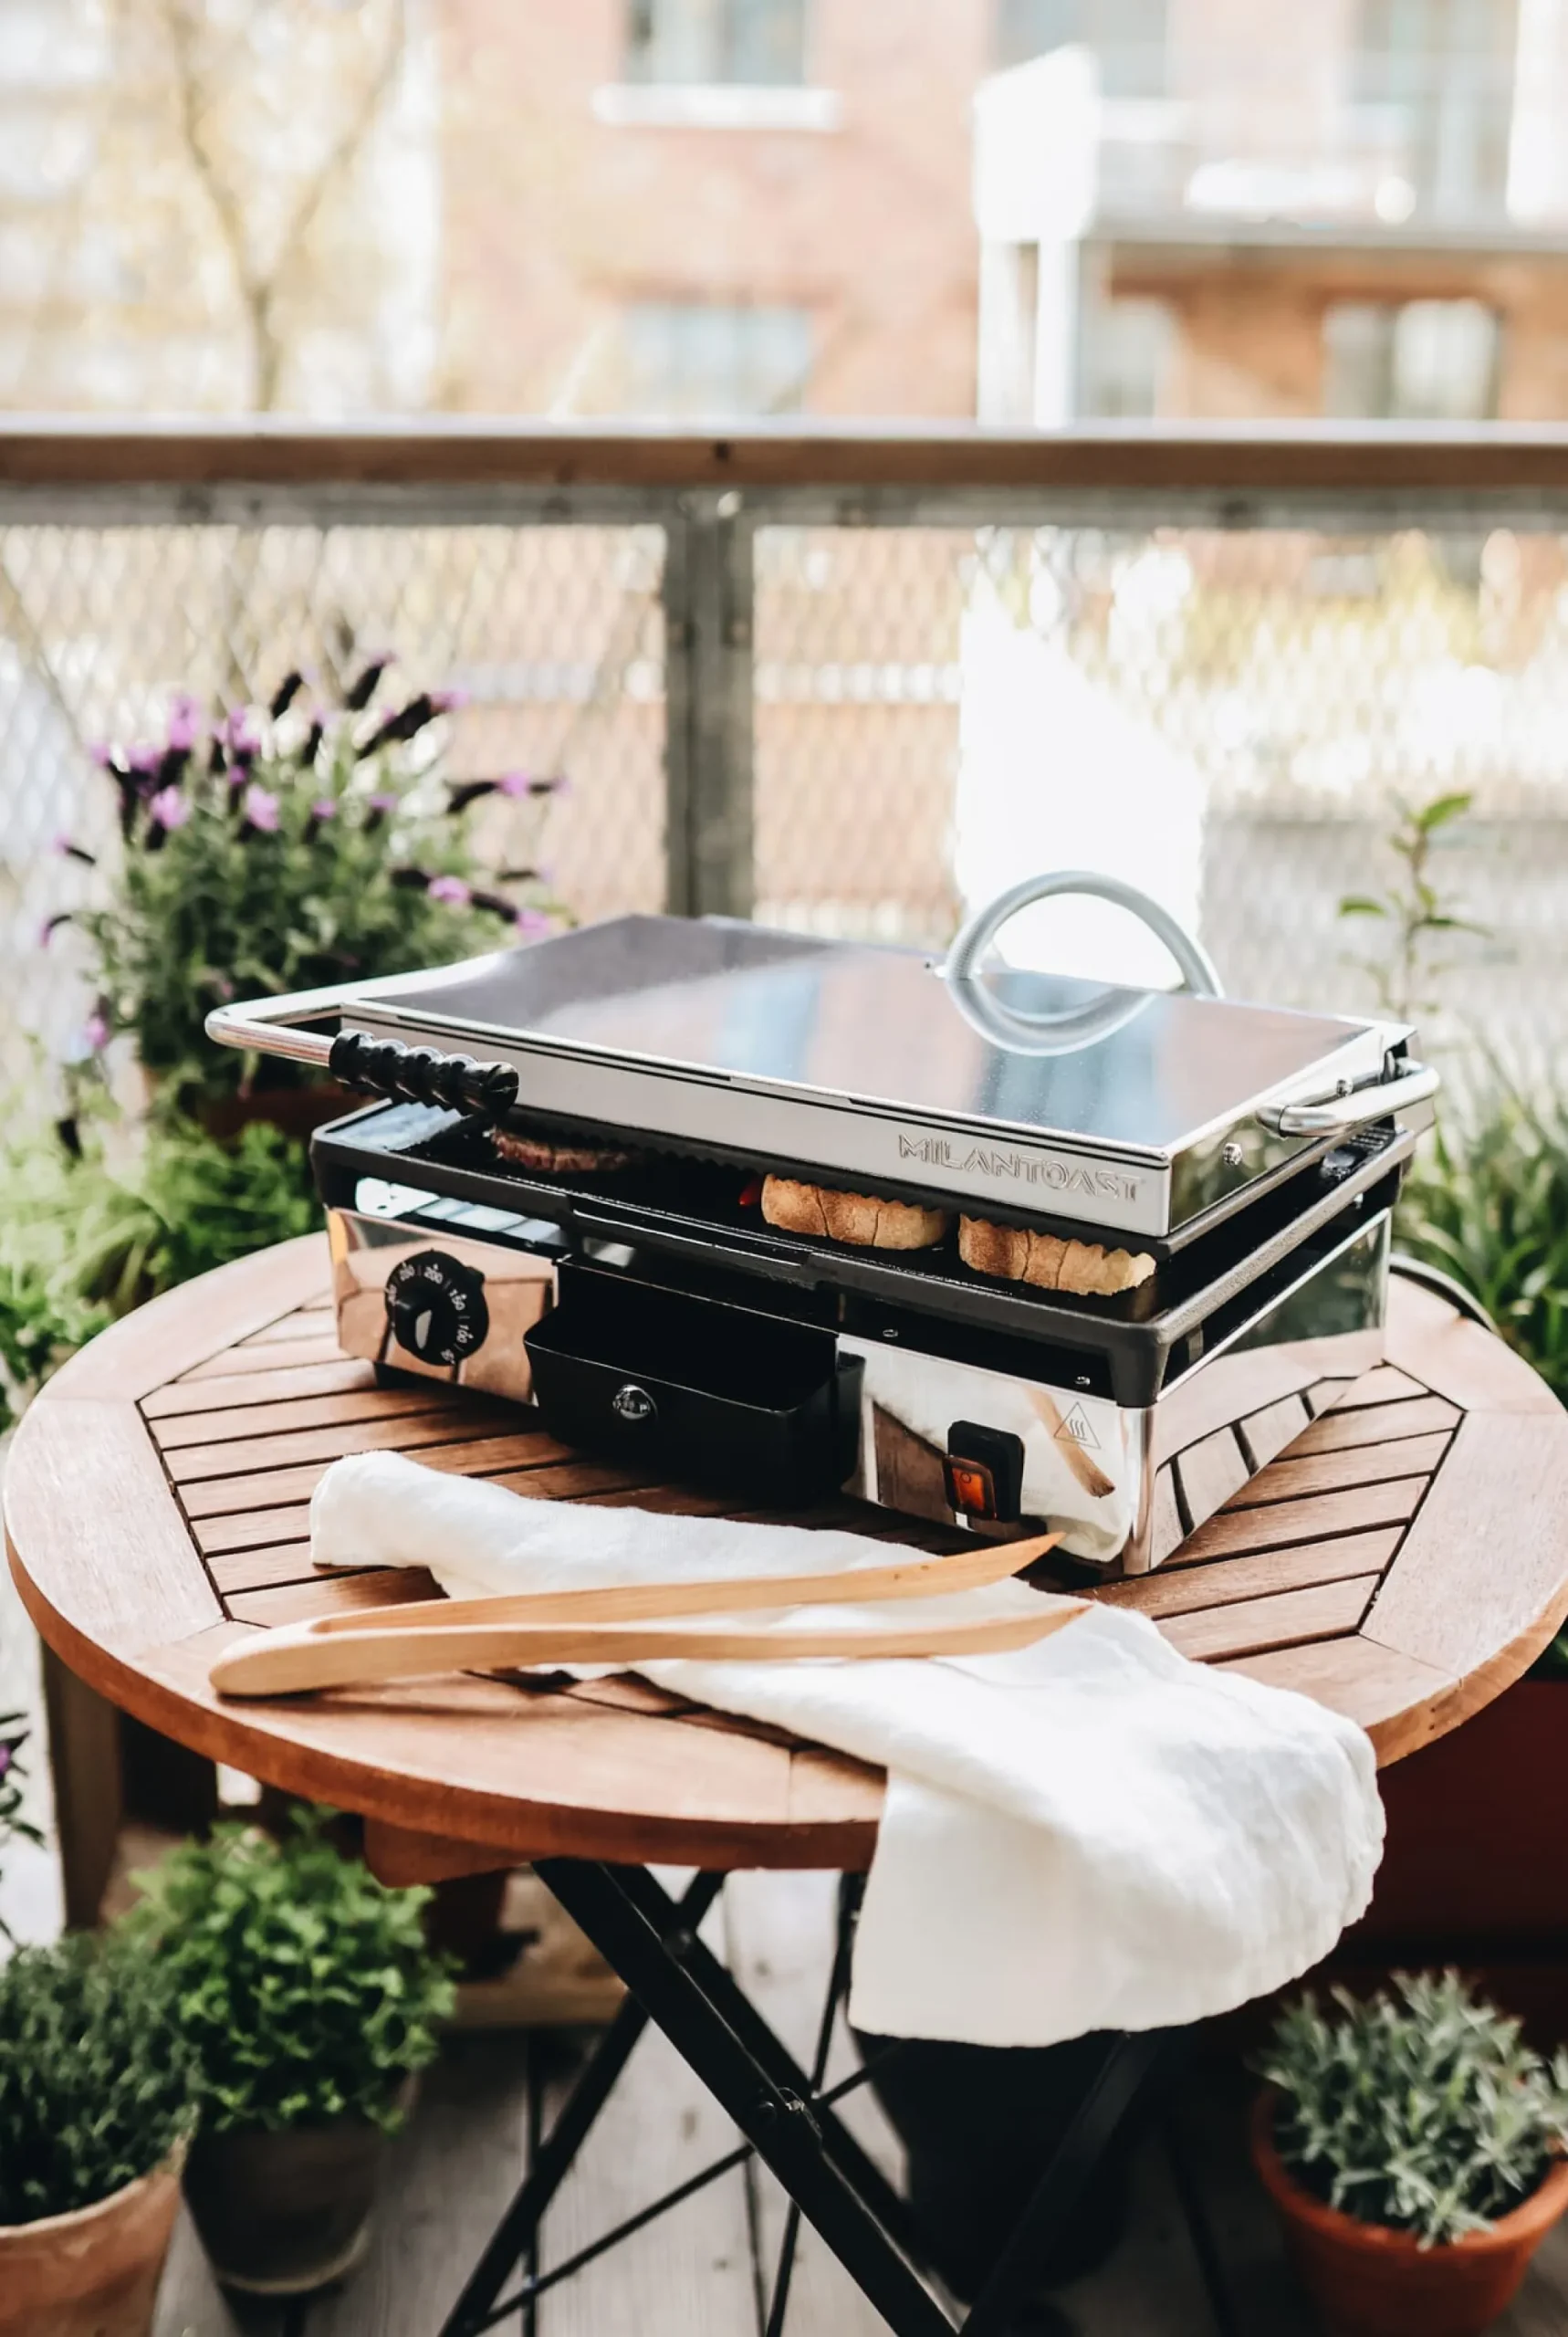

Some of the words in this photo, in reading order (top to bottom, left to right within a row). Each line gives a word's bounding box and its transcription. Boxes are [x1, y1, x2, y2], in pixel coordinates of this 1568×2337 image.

[898, 1133, 1146, 1201] MILANTOAST
[423, 1266, 444, 1284] 200
[448, 1289, 466, 1311] 150
[456, 1325, 469, 1343] 100
